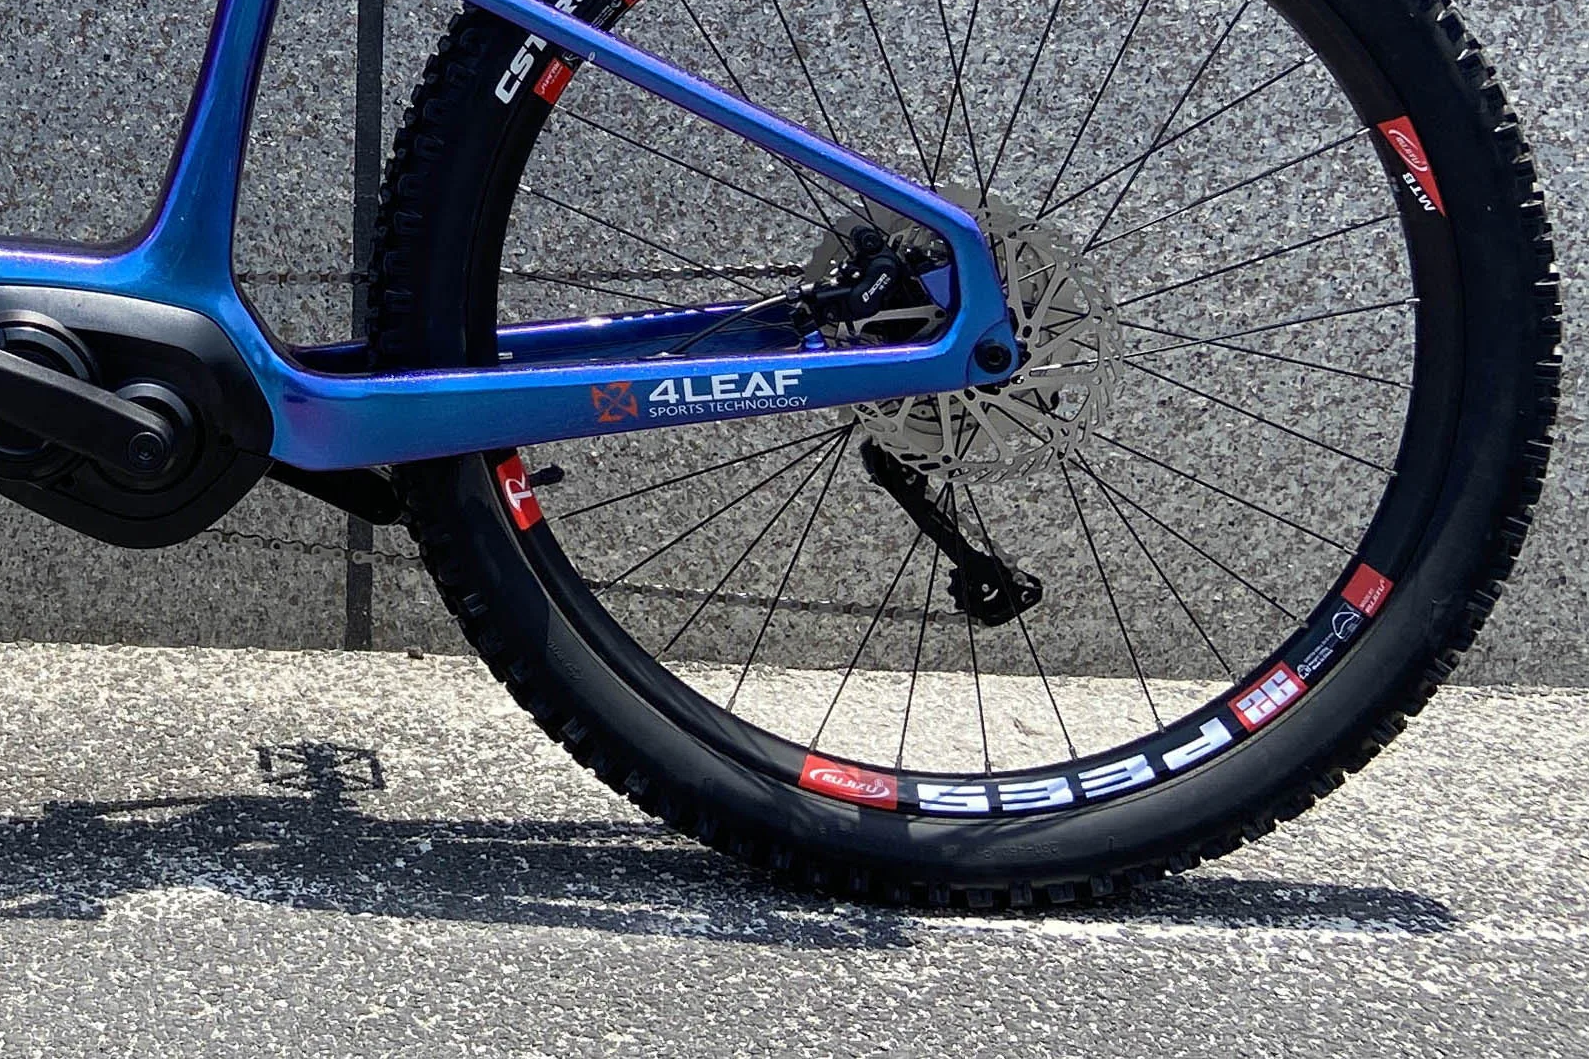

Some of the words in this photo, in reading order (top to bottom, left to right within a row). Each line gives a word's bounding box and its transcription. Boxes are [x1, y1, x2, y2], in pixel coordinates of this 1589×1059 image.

[1402, 172, 1437, 211] MTB
[649, 368, 803, 404] 4LEAF
[649, 403, 704, 418] SPORTS
[709, 396, 809, 413] TECHNOLOGY
